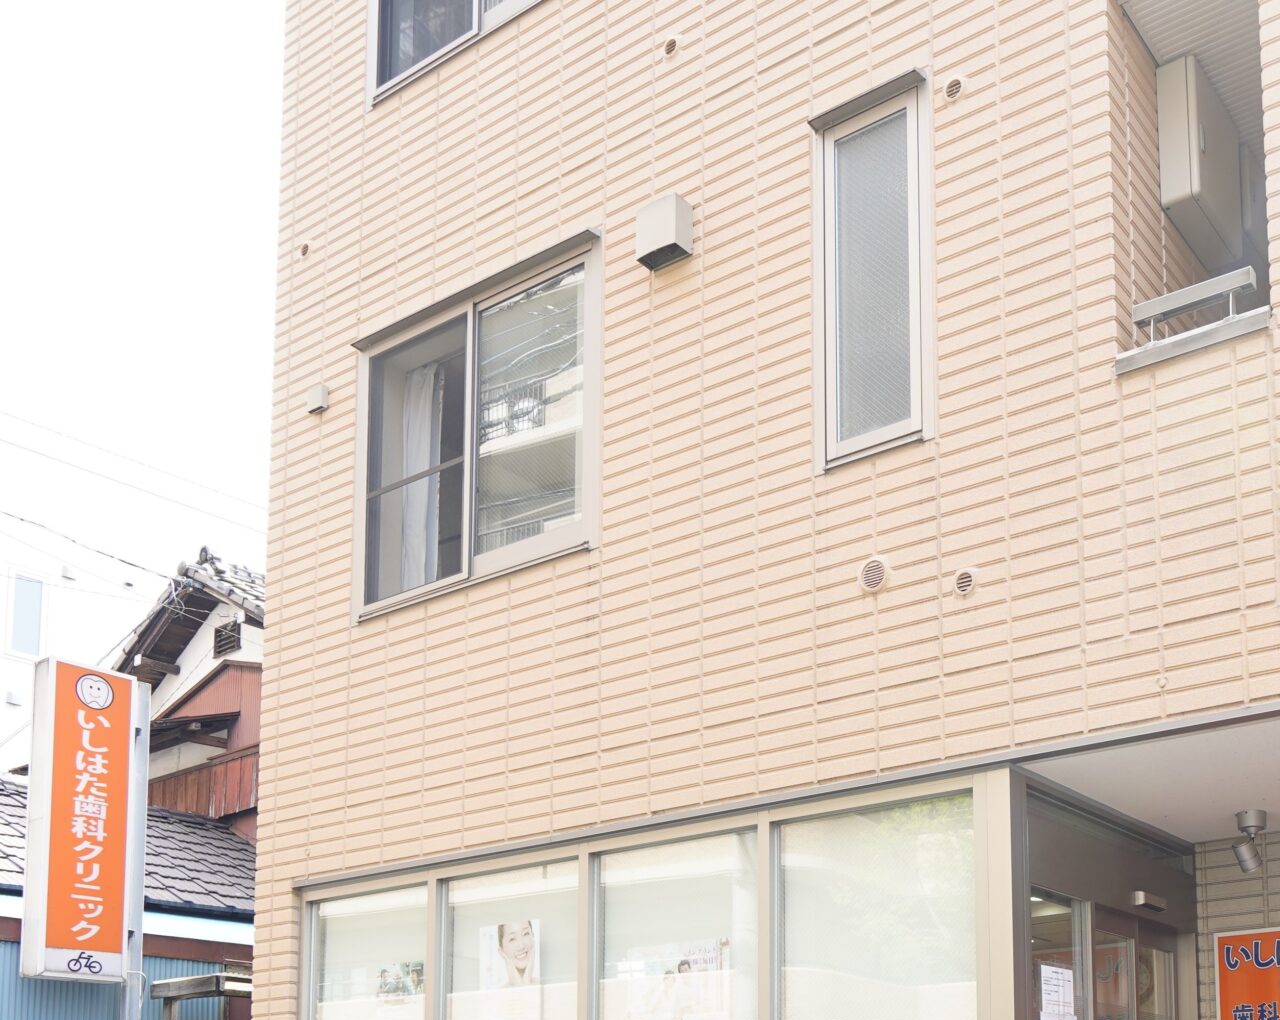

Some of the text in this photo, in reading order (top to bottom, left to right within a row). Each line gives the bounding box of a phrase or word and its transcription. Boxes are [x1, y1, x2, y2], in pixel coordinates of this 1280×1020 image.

[70, 709, 111, 942] いしはた歯科クリニック
